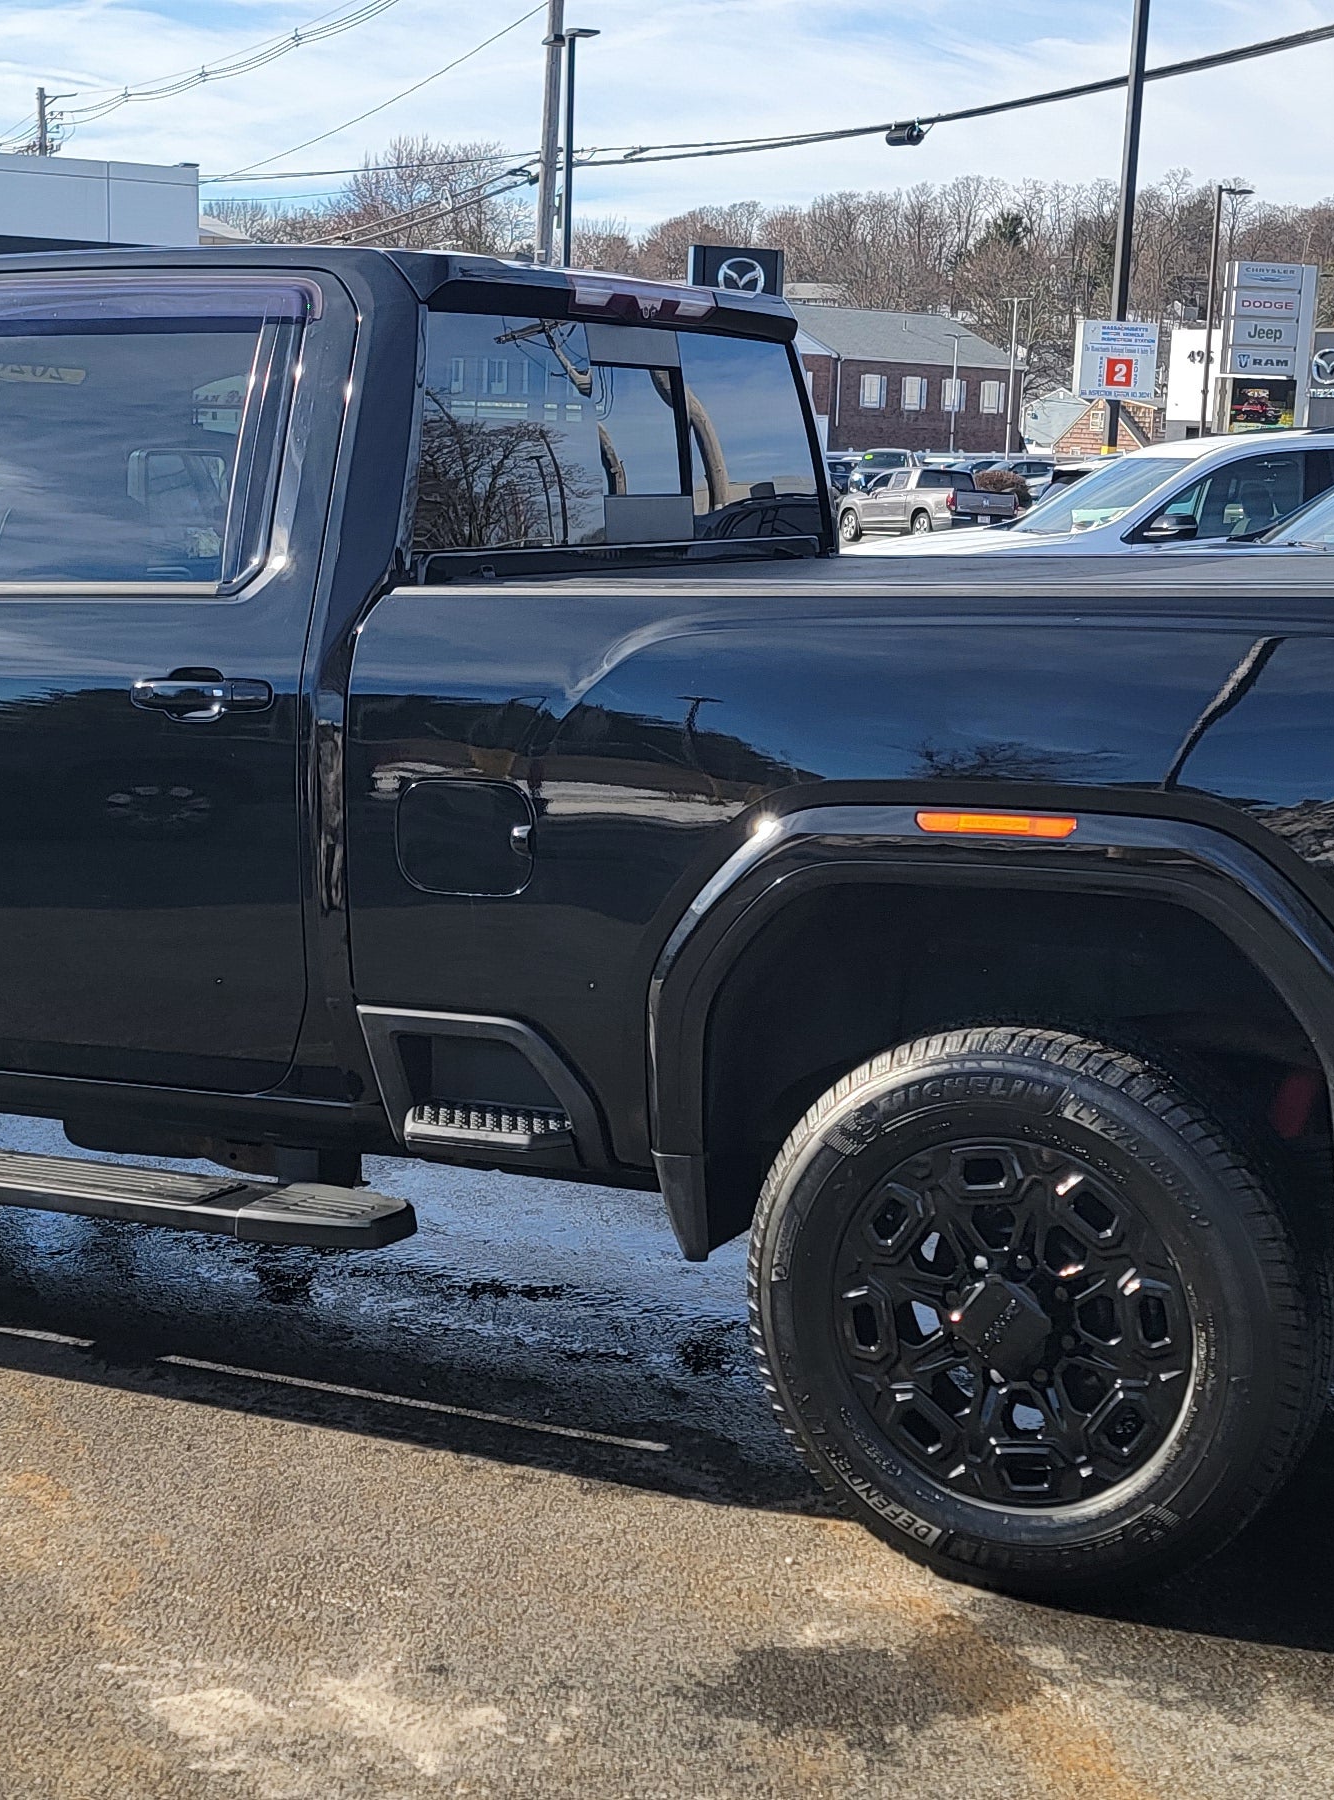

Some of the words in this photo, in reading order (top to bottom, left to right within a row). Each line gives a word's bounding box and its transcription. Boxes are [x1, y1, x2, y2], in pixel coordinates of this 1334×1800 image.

[1245, 266, 1295, 275] CHRYSLER
[1241, 299, 1294, 310] DODGE
[1247, 324, 1283, 342] Jeep
[1252, 358, 1289, 367] RAM
[1113, 363, 1127, 382] 2
[870, 1076, 1051, 1118] MICHELIN
